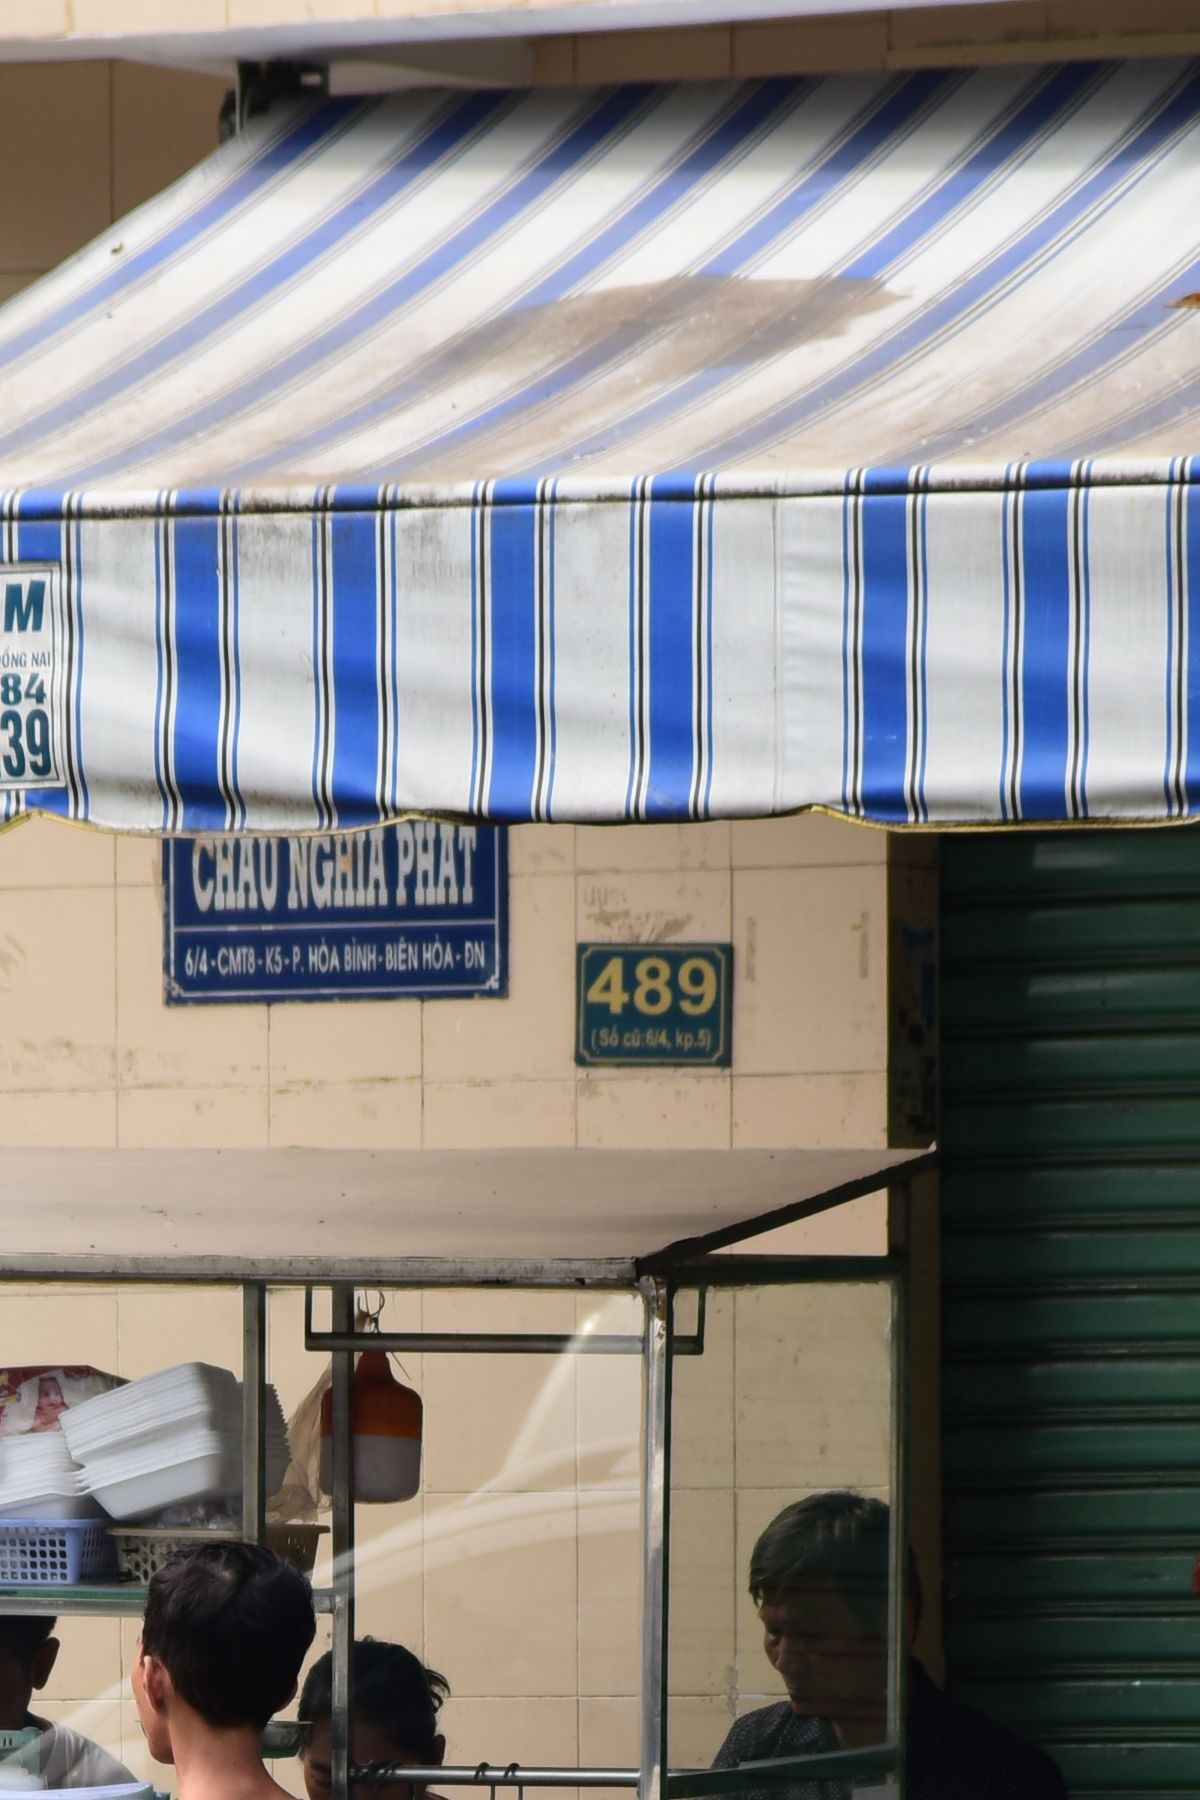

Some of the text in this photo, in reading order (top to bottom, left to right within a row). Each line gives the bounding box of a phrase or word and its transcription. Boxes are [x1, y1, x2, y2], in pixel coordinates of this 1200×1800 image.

[309, 937, 340, 973] HÒA
[344, 935, 376, 972] BÌNH
[385, 935, 418, 970] BIÊN
[422, 934, 453, 970] HÒA
[586, 957, 717, 1016] 489
